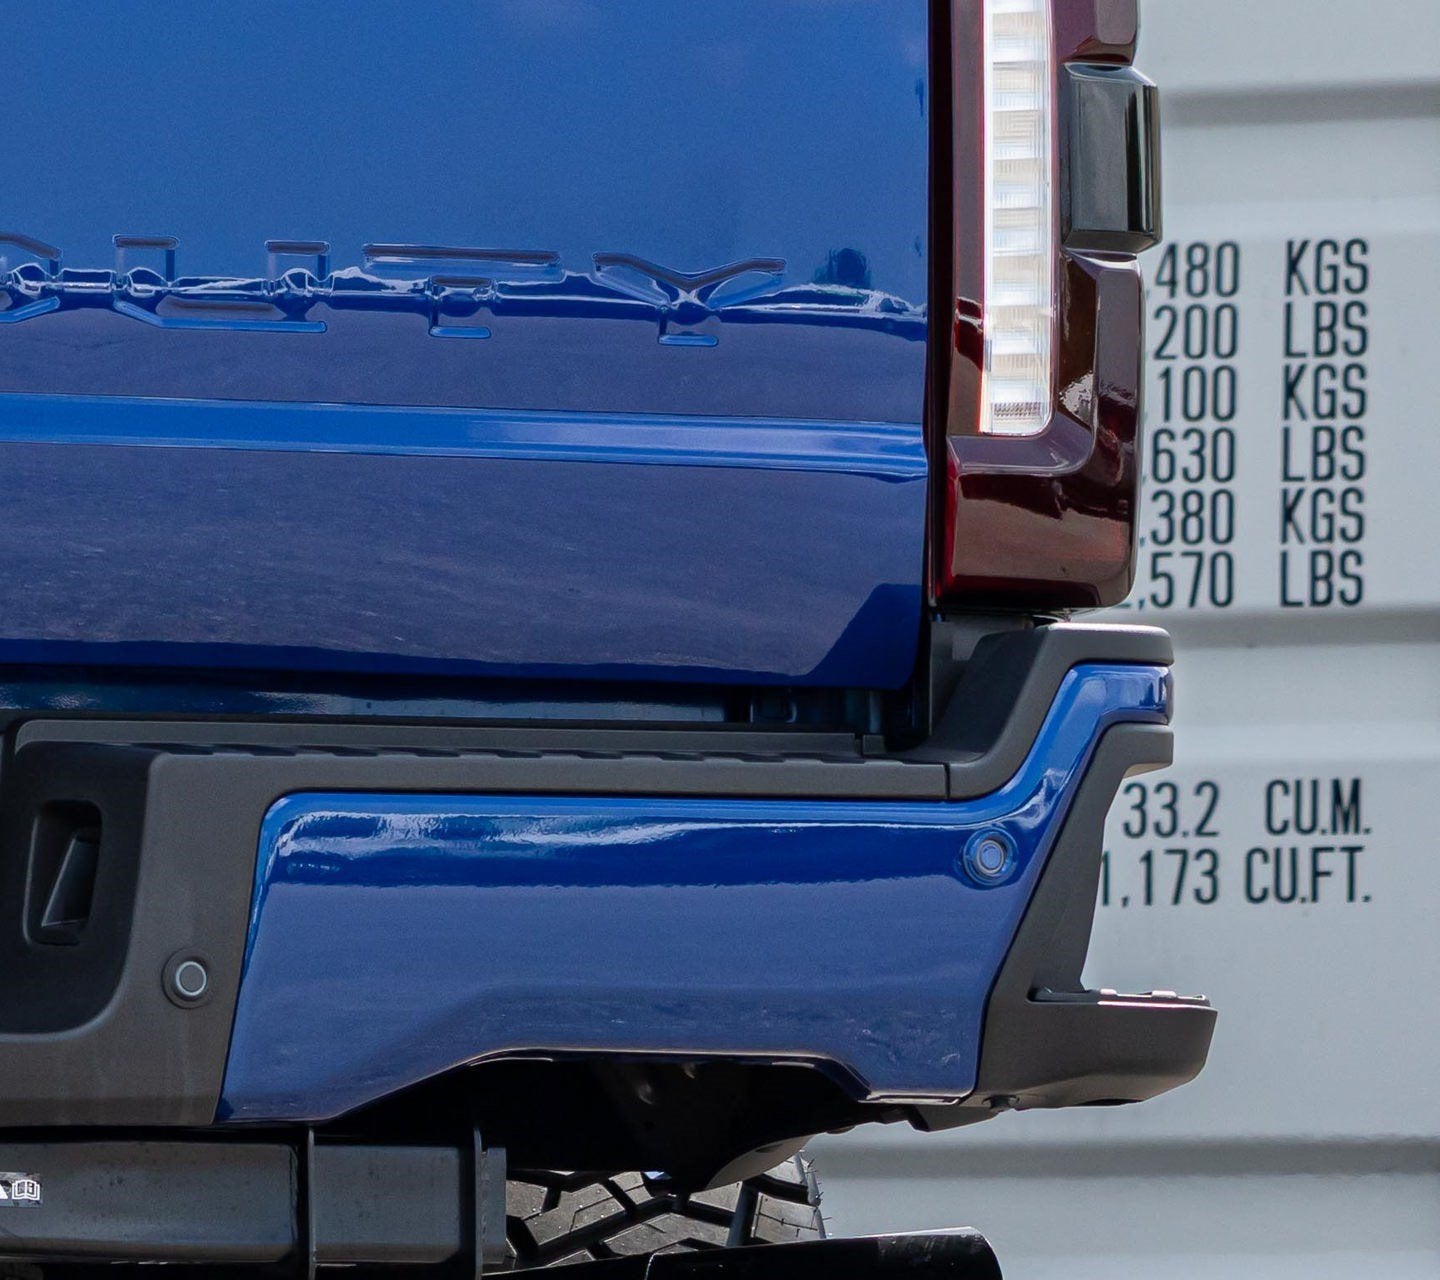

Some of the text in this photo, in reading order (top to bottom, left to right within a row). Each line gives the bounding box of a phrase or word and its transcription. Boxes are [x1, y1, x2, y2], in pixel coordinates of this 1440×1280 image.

[1284, 237, 1369, 297] KGS
[1283, 300, 1369, 359] LBS
[1283, 362, 1368, 421] KGS
[1281, 425, 1366, 483] LBS
[1280, 486, 1365, 545] KGS
[1122, 549, 1364, 609] ,570 LBS
[1122, 777, 1372, 839] 33.2 CU.M.
[1101, 847, 1219, 907] 1,173
